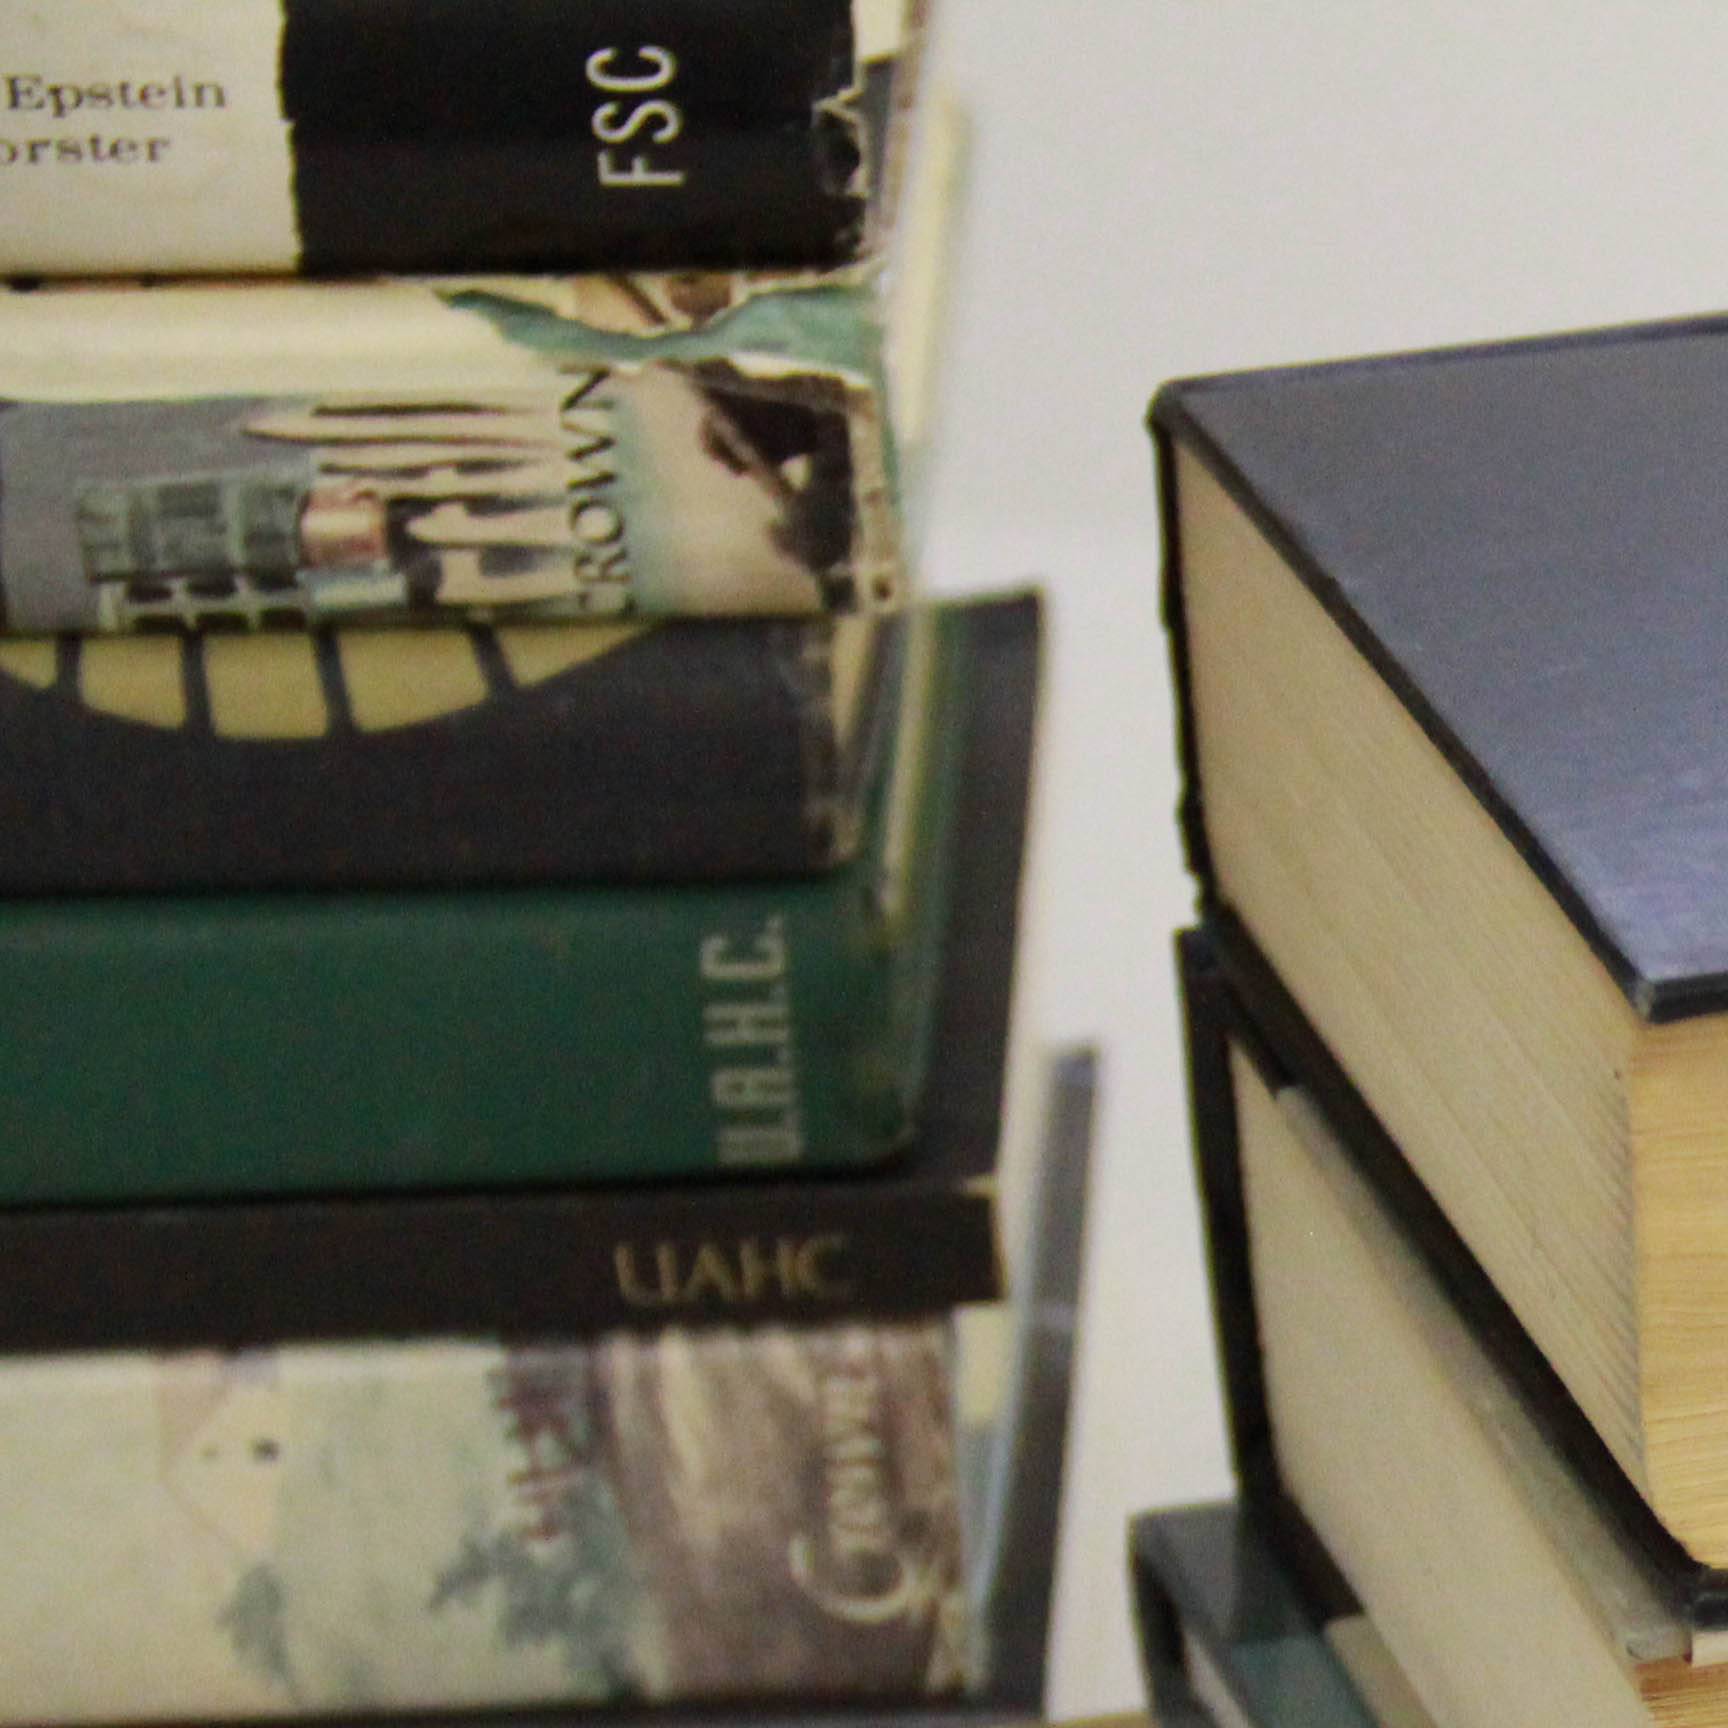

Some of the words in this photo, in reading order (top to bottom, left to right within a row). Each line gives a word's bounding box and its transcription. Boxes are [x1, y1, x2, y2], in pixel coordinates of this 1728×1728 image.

[3, 73, 228, 118] Epstein
[586, 45, 686, 186] FSC
[614, 1234, 848, 1304] UAHC
